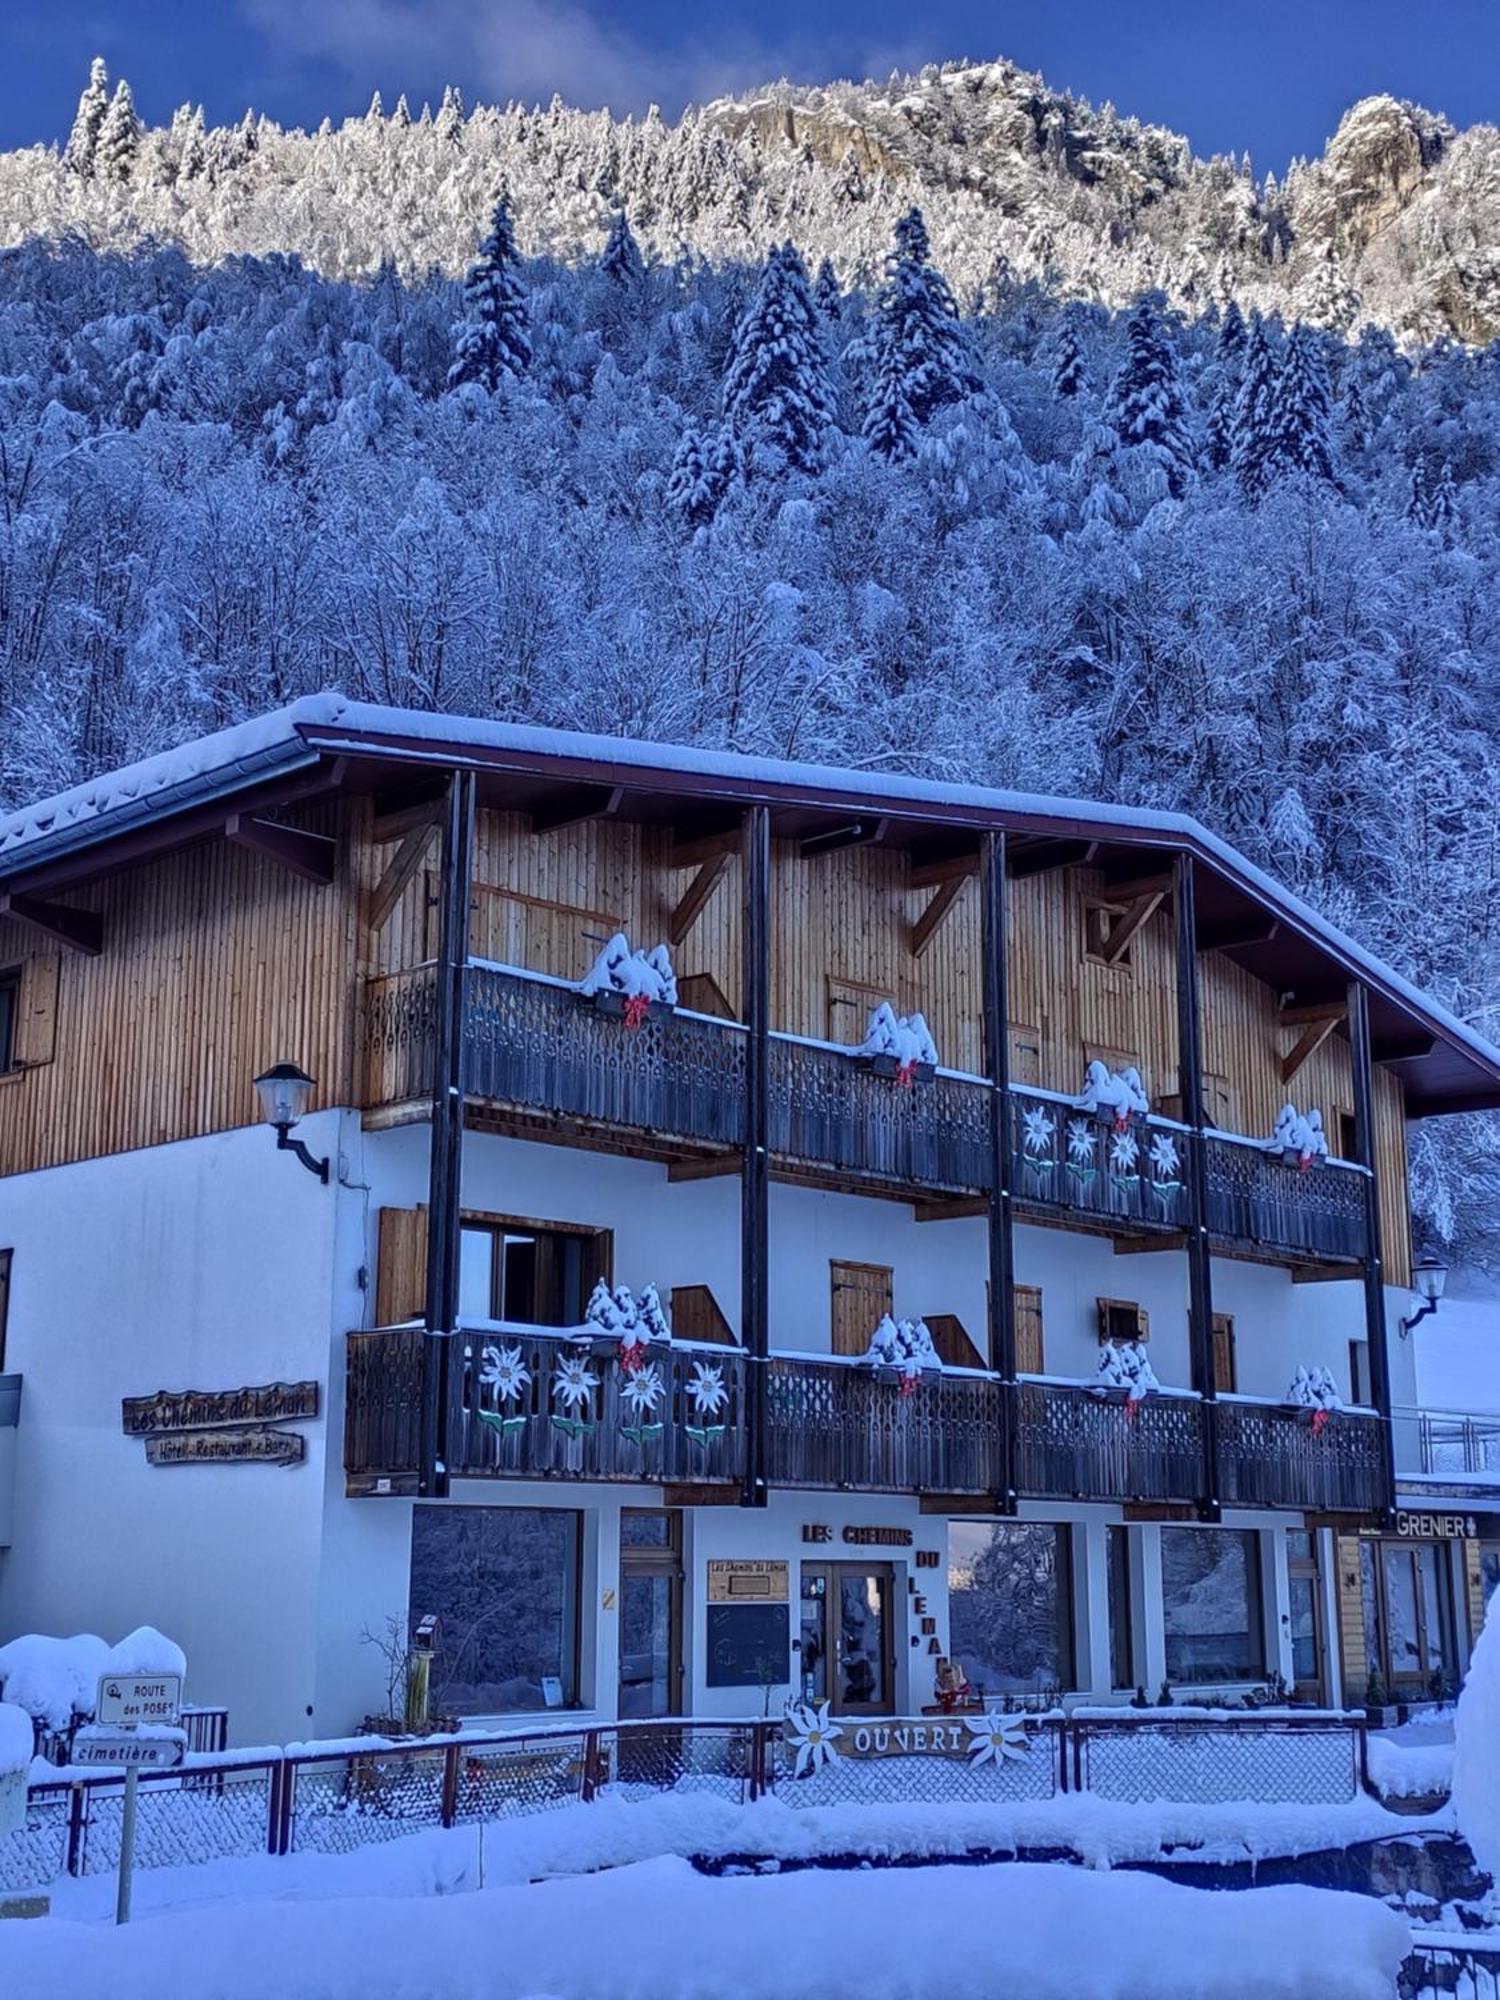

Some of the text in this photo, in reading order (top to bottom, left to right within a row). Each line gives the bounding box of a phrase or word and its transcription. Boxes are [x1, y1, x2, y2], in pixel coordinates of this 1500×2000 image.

[131, 1409, 156, 1431] Les
[162, 1400, 226, 1428] Chemins
[195, 1437, 254, 1459] Restaurant
[1396, 1511, 1466, 1537] GRENIER
[802, 1524, 914, 1547] LES CHEMINS
[915, 1550, 940, 1568] DU
[133, 1685, 166, 1697] ROUTE
[123, 1704, 139, 1715] des
[855, 1726, 962, 1752] OUVERT
[78, 1744, 157, 1761] cimetière
